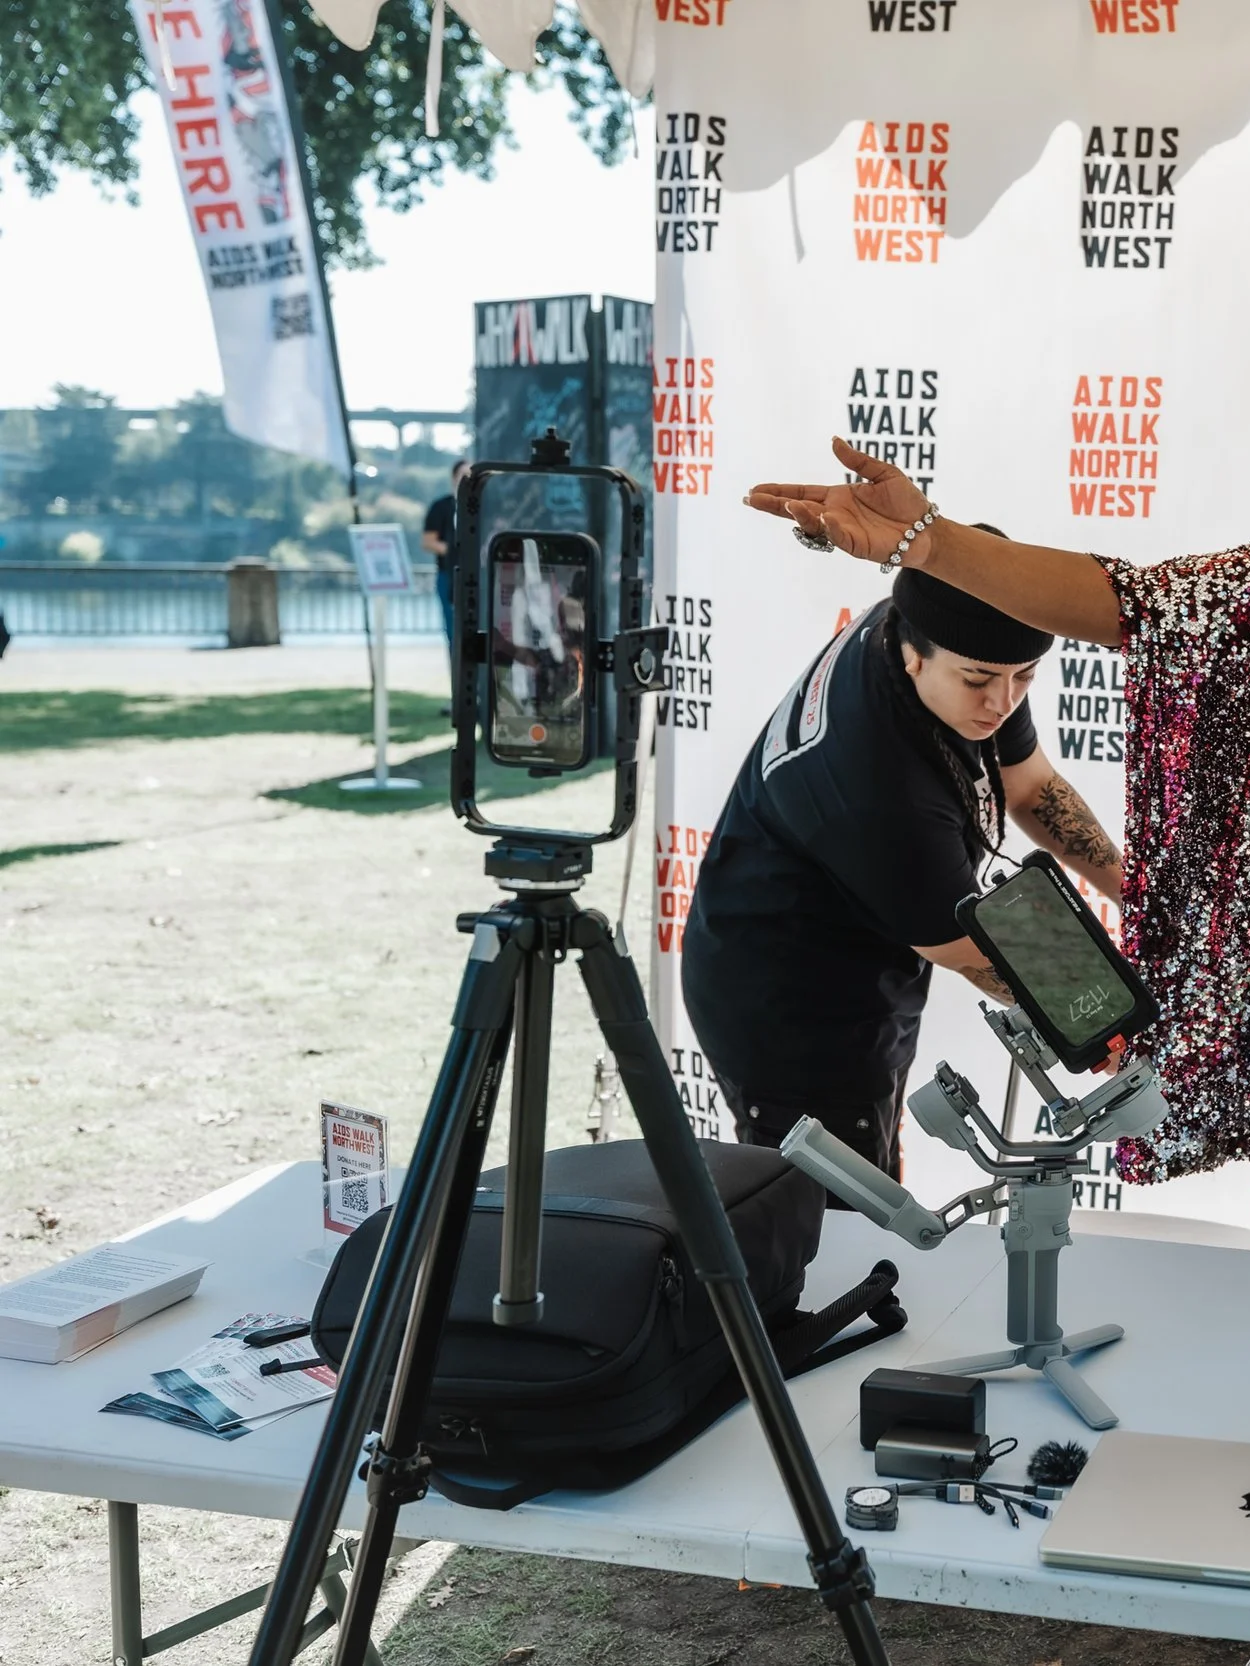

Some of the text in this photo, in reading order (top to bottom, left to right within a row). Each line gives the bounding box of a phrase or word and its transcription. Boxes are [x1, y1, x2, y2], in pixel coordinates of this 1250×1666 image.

[868, 0, 957, 32] WEST
[1090, 0, 1178, 33] WEST
[657, 113, 726, 146] IDS
[858, 121, 949, 153] AIDS
[1085, 126, 1178, 158] AIDS
[161, 65, 245, 234] HERE
[855, 158, 947, 191] WALK
[1083, 164, 1176, 196] WALK
[657, 187, 721, 214] ORTH
[853, 195, 946, 225] NORTH
[1081, 200, 1174, 230] NORTH
[854, 231, 940, 263] WEST
[1081, 236, 1171, 268] WEST
[849, 368, 938, 400] AIDS
[1073, 375, 1162, 408] AIDS
[847, 404, 936, 437] WALK
[1071, 413, 1159, 445] WALK
[657, 429, 713, 457] ORTH
[1070, 449, 1158, 478] NORTH
[1070, 484, 1155, 517] WEST
[655, 595, 712, 627] IDS
[669, 630, 712, 663] ALK
[662, 664, 712, 695] ORTH
[1060, 657, 1124, 691] WAL
[1058, 694, 1125, 725] NORT
[1058, 727, 1124, 762] WES
[1069, 984, 1110, 1022] 11:27
[681, 1082, 719, 1117] ALK
[332, 1123, 374, 1144] AIDS WALK
[332, 1134, 375, 1156] NORTHWEST
[336, 1155, 372, 1170] DONATE HERE
